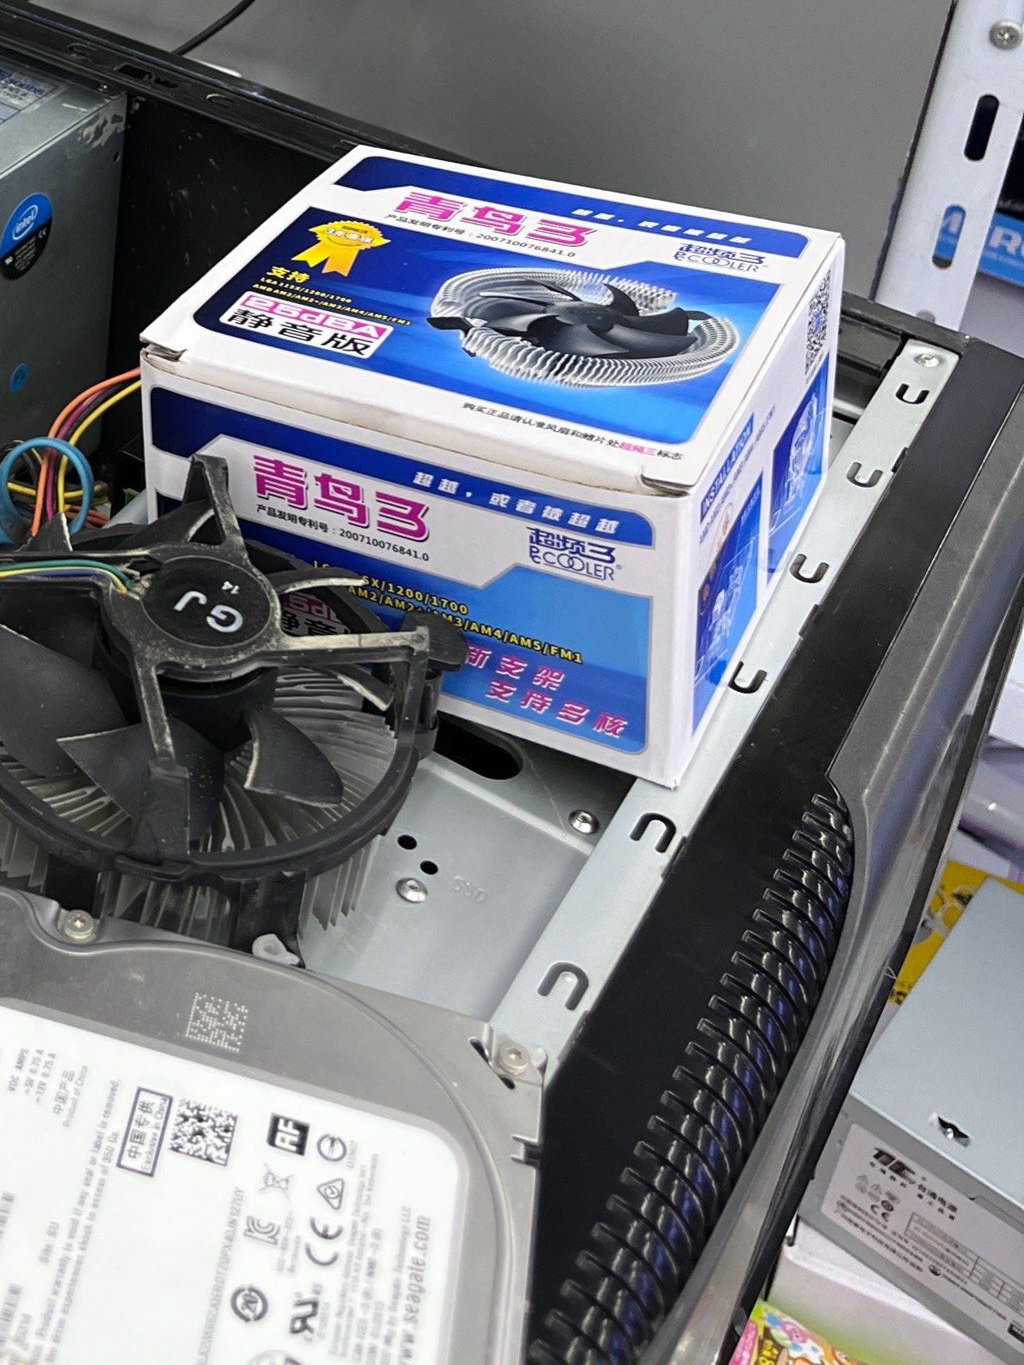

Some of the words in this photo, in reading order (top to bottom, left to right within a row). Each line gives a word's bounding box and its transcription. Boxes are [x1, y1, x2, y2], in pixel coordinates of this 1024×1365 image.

[227, 308, 374, 356] 静音版
[243, 297, 387, 339] 25dBA
[485, 679, 628, 739] 支持多核
[128, 1099, 156, 1160] 中国专供
[275, 1117, 306, 1153] AF
